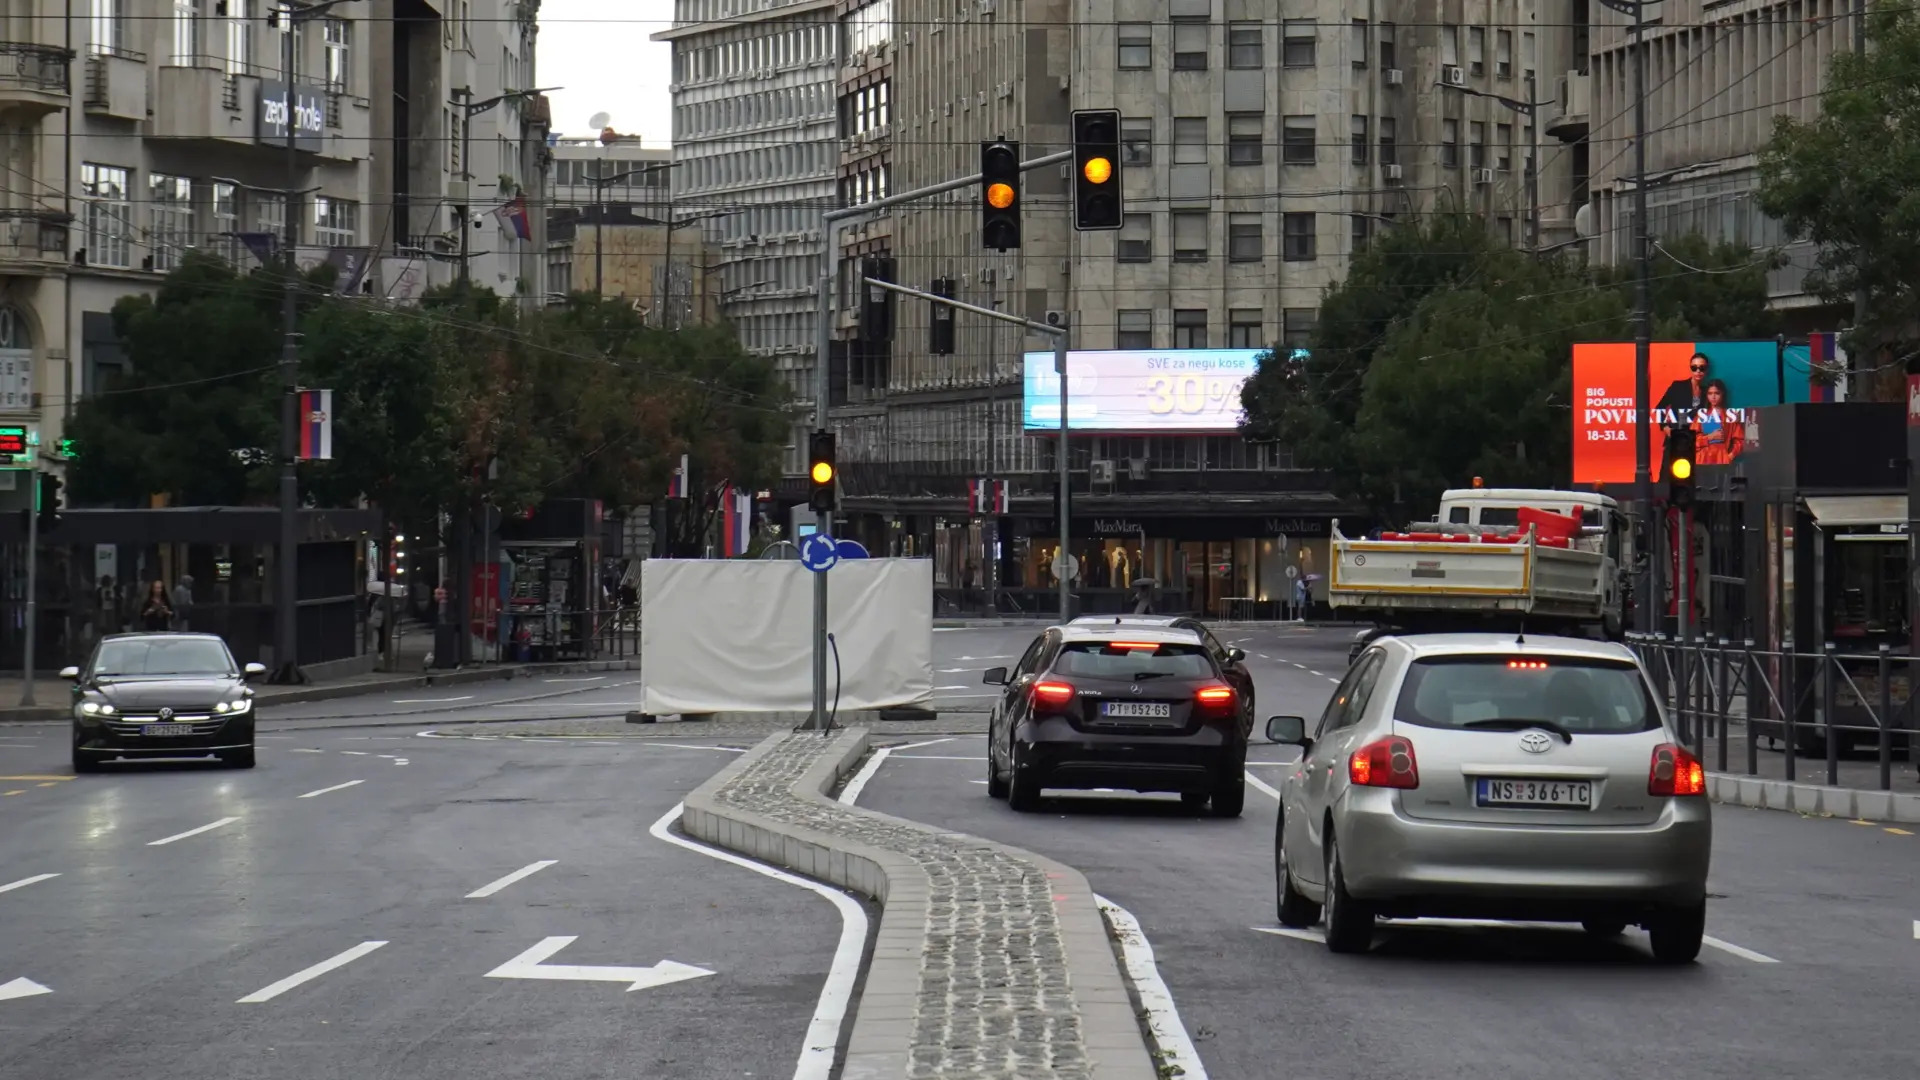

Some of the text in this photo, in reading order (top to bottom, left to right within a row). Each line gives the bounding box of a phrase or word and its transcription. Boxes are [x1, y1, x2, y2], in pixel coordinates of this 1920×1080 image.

[1147, 357, 1246, 371] SVE za negu kose
[1586, 387, 1606, 397] BIG
[1585, 397, 1633, 407] POPUSTI
[1697, 407, 1722, 424] SA
[1586, 430, 1629, 441] 18-31.8.
[1094, 519, 1143, 533] MaxMara
[1109, 703, 1123, 715] PT
[1491, 782, 1513, 800] NS
